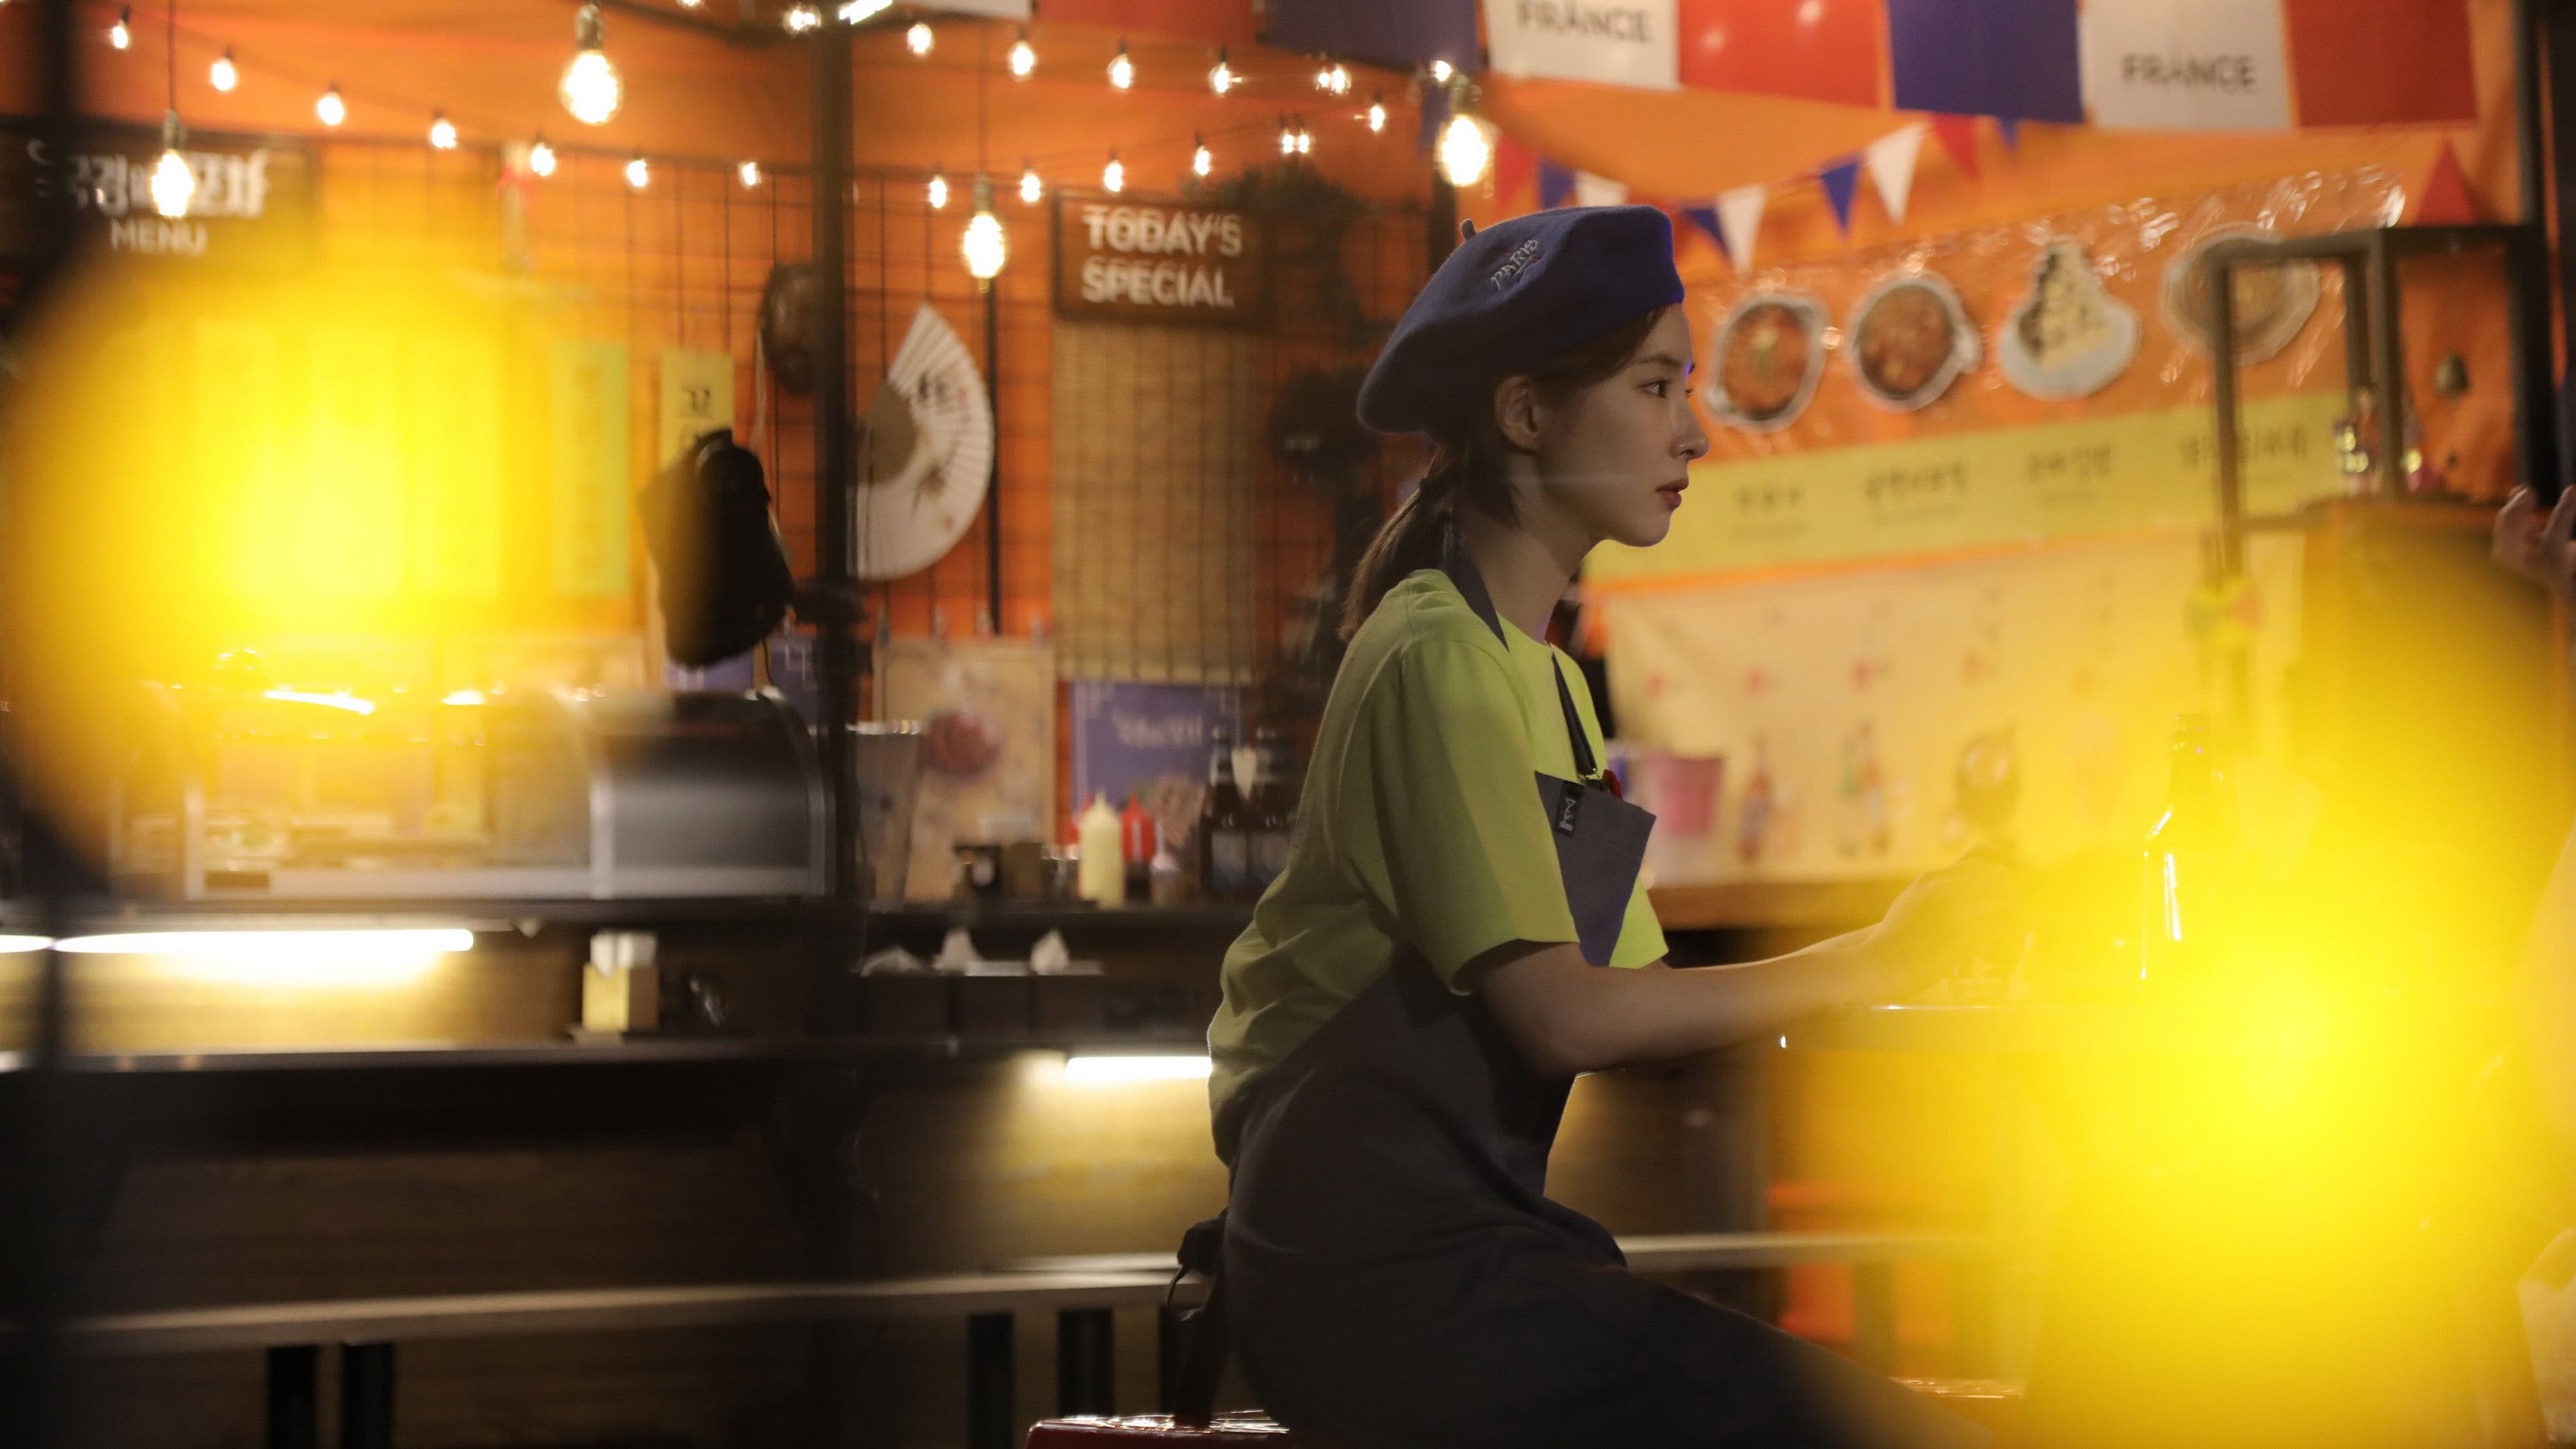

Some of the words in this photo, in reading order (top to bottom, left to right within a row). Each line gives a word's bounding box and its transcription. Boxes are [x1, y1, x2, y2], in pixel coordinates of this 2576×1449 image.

[1515, 0, 1653, 44] FRANCE
[2120, 51, 2255, 95] FRANCE
[111, 219, 209, 256] MENU
[1081, 204, 1243, 258] TODAY'S
[1081, 256, 1235, 308] SPECIAL
